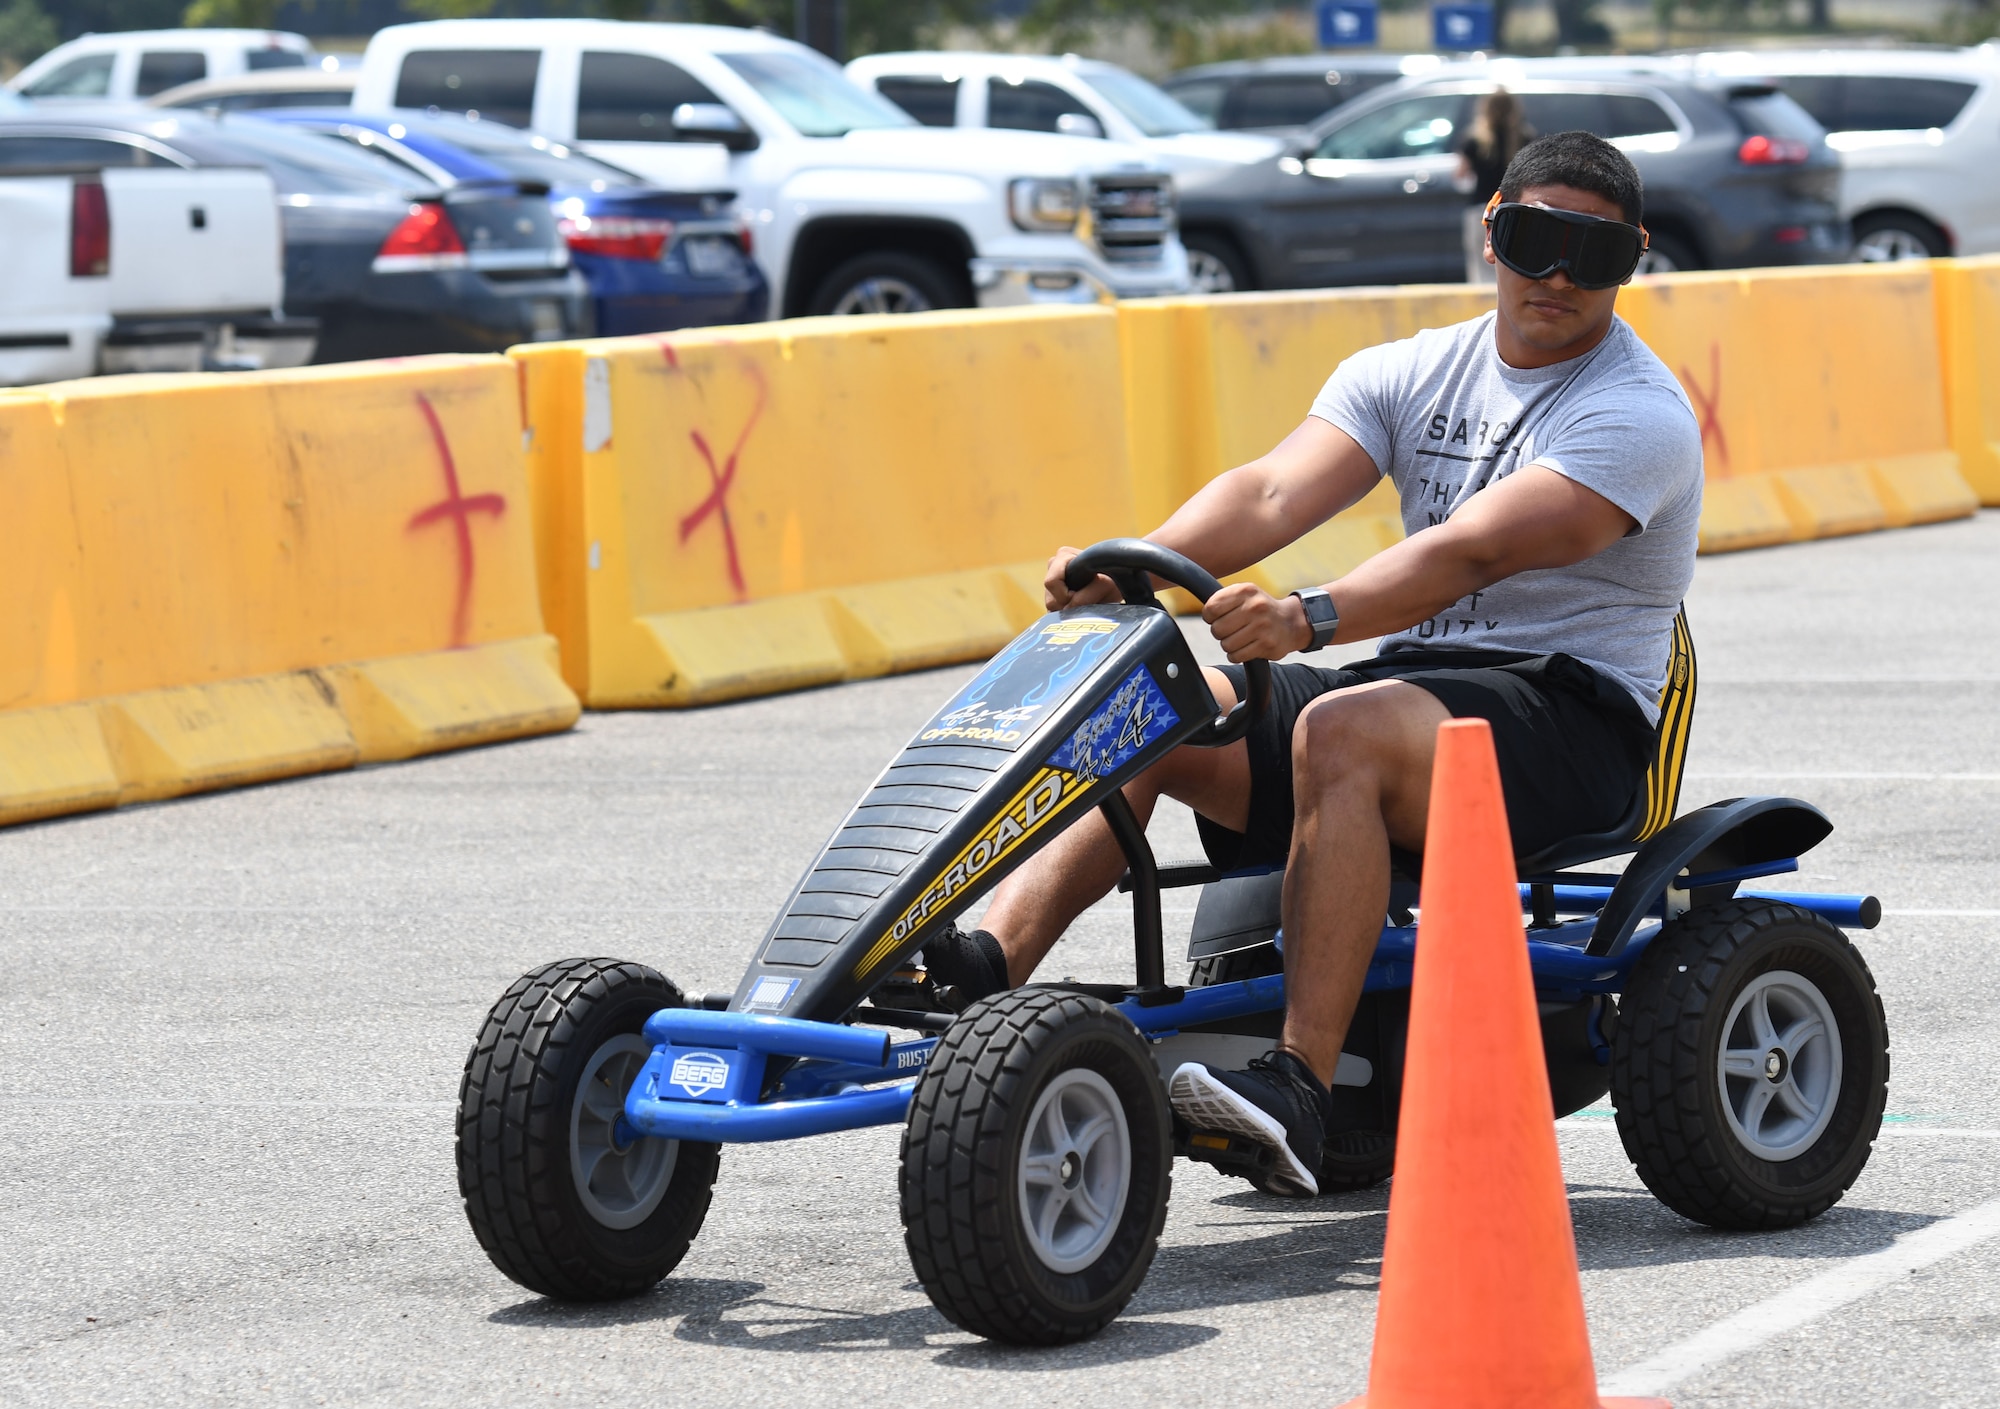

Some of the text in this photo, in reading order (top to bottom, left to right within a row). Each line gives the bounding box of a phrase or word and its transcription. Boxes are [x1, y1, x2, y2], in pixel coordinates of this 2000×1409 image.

[1043, 623, 1118, 633] BERG
[941, 701, 1043, 728] 4x4
[921, 727, 1021, 742] OFF-ROAD
[1076, 691, 1155, 783] 4x4
[891, 774, 1063, 941] OFF-ROAD
[897, 1049, 933, 1069] BUST
[673, 1062, 727, 1085] BERG
